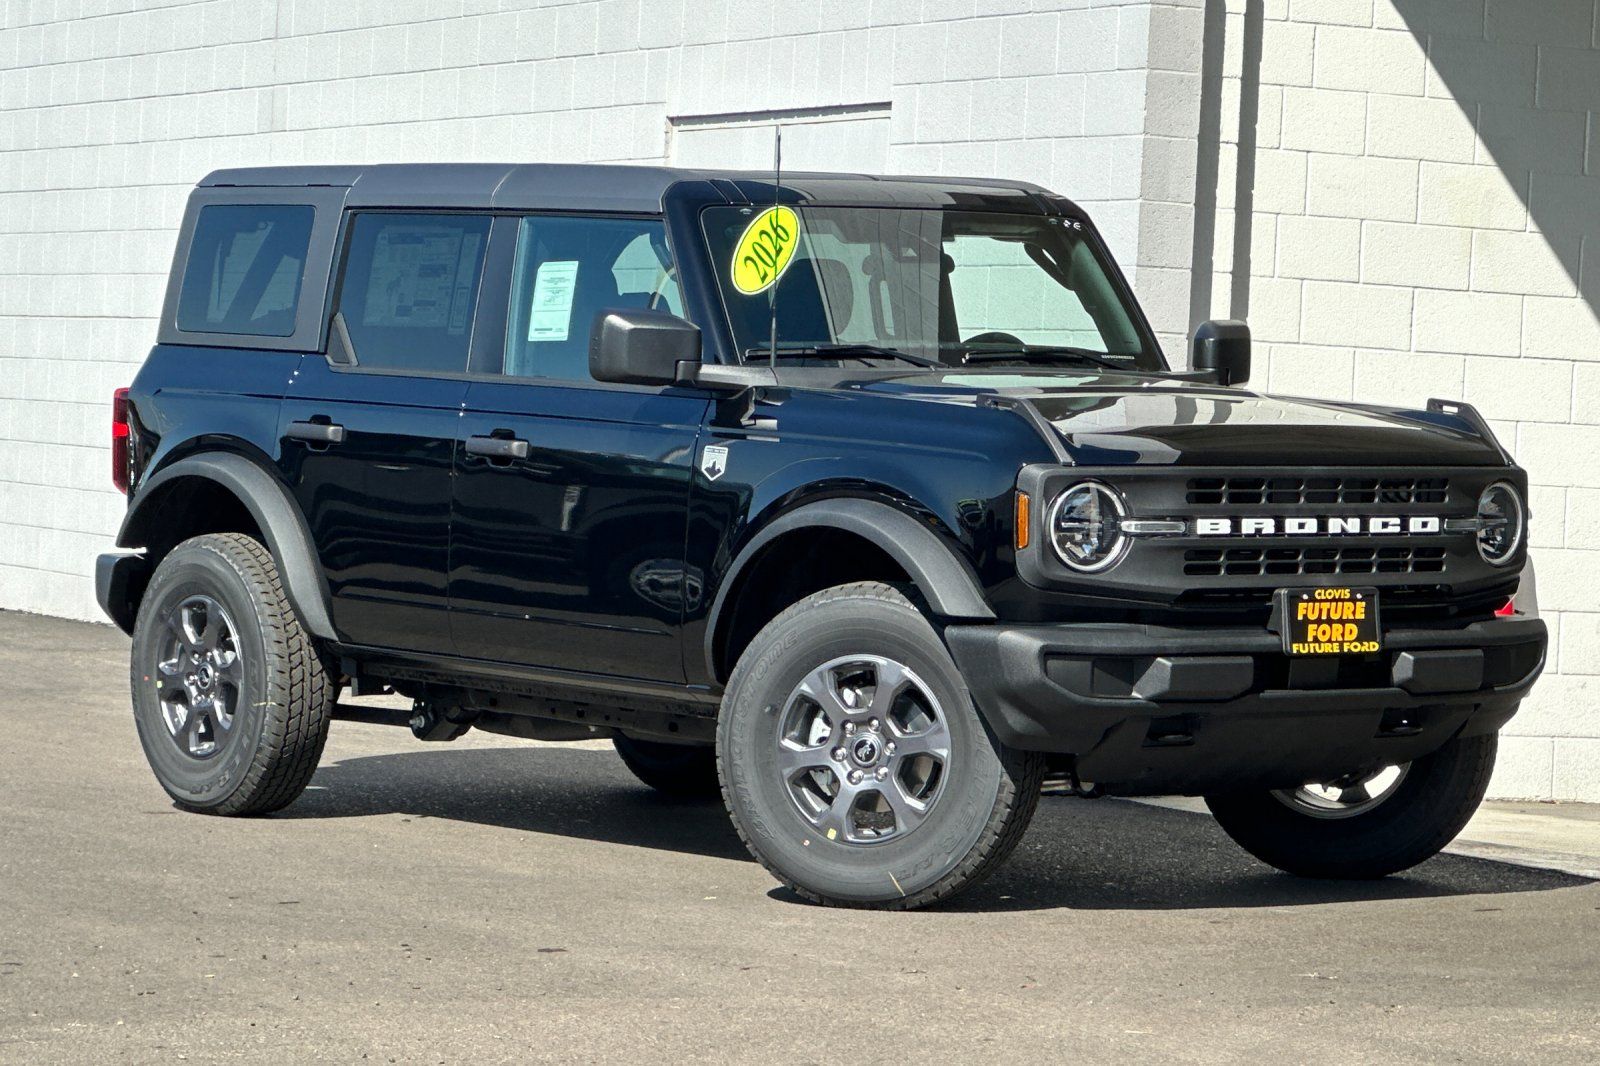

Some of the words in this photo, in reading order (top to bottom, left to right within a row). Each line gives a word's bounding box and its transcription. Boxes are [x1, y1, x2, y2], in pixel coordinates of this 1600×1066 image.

[743, 213, 790, 284] 2026
[1196, 517, 1440, 535] BRONCO
[1314, 588, 1351, 600] CLOVIS
[1297, 601, 1366, 620] FUTURE
[1307, 623, 1358, 642] FORD
[1292, 642, 1340, 654] FUTURE
[1343, 641, 1380, 653] FORD
